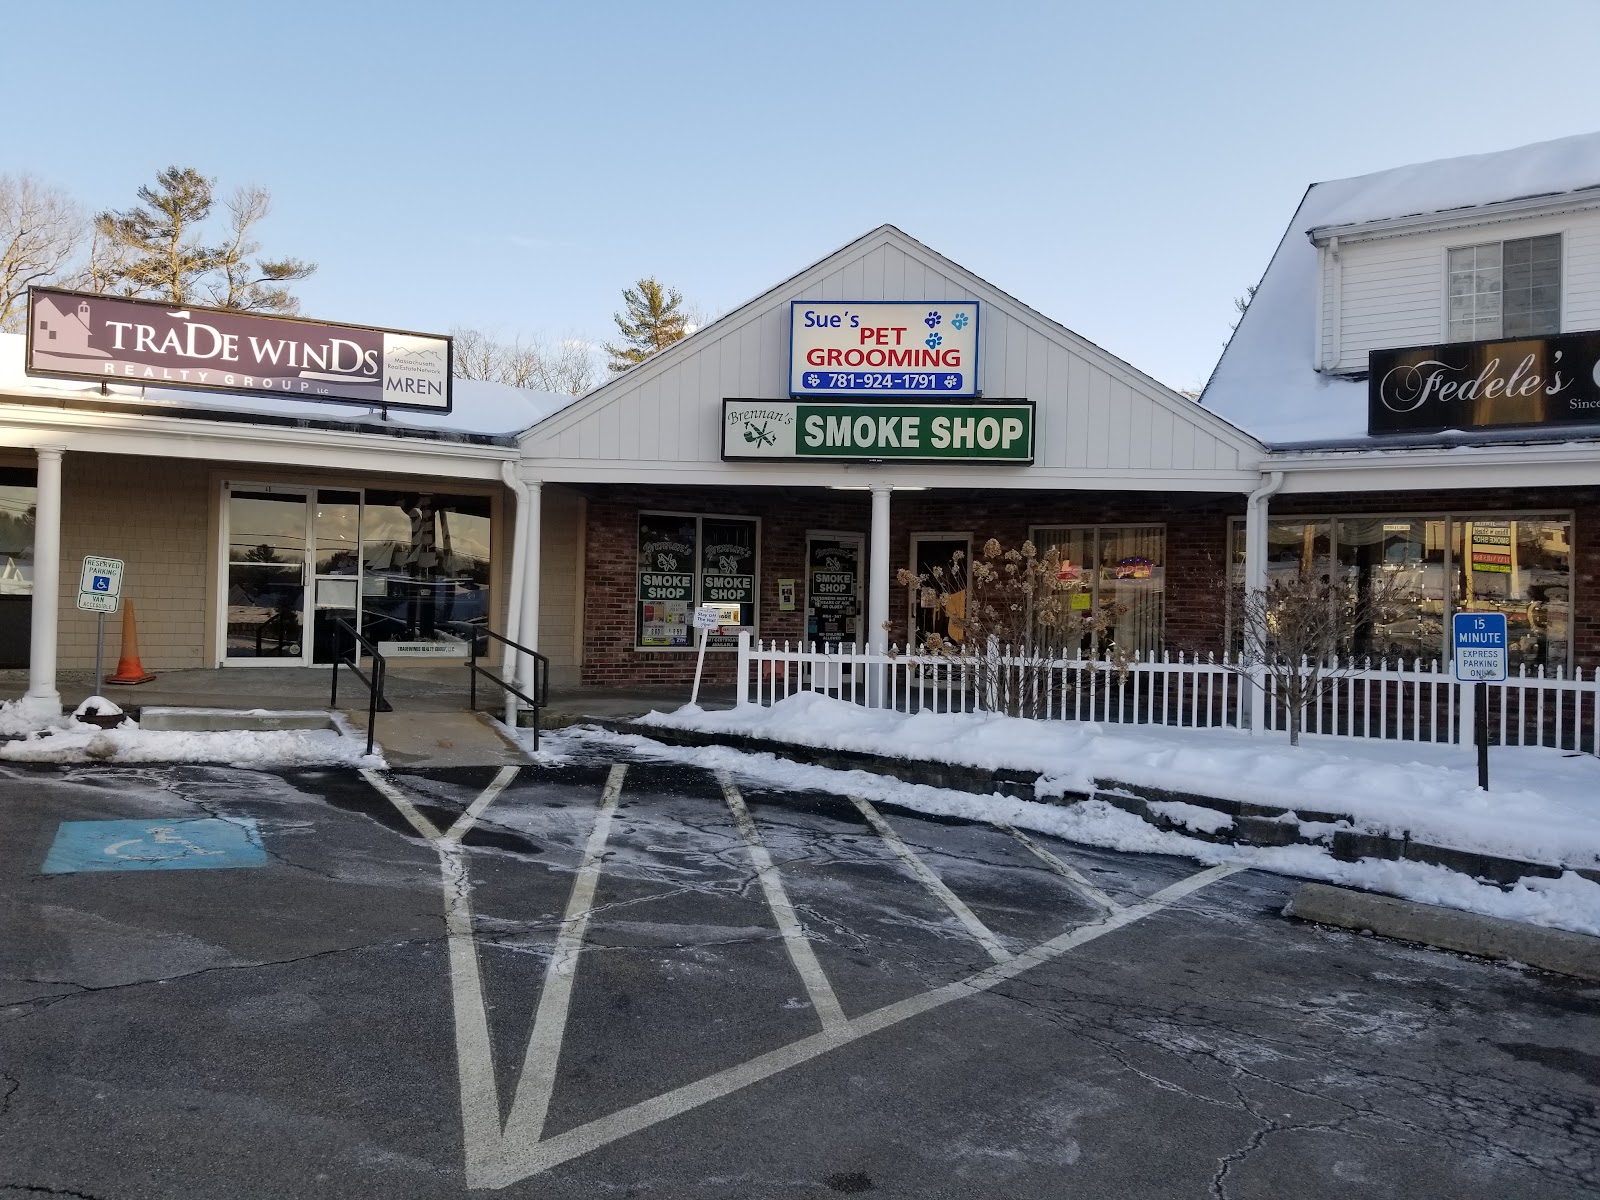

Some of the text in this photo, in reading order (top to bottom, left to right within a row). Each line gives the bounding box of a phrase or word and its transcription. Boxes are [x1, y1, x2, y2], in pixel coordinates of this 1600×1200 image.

[804, 310, 859, 328] Sue's
[860, 327, 907, 345] PET
[105, 320, 378, 376] TRADE WINDS
[394, 357, 435, 367] Massachusetts
[806, 348, 961, 367] GROOMING
[104, 362, 208, 383] REALTY
[224, 374, 310, 392] GROUP
[828, 373, 936, 388] 781-924-1791
[1380, 350, 1574, 413] Fedele's
[386, 376, 442, 396] MREN
[727, 409, 794, 426] Brennan's
[804, 415, 1023, 450] SMOKE SHOP
[87, 560, 120, 569] RESERVED
[89, 567, 117, 576] PARKING
[643, 575, 691, 587] SMOKE
[705, 577, 751, 588] SMOKE
[815, 574, 851, 584] SMOKE
[648, 587, 685, 598] SHOP
[820, 584, 846, 592] SHOP
[710, 589, 746, 600] SHOP
[1474, 619, 1486, 630] 15
[1459, 632, 1502, 643] MINUTE
[1463, 660, 1498, 668] PARKING
